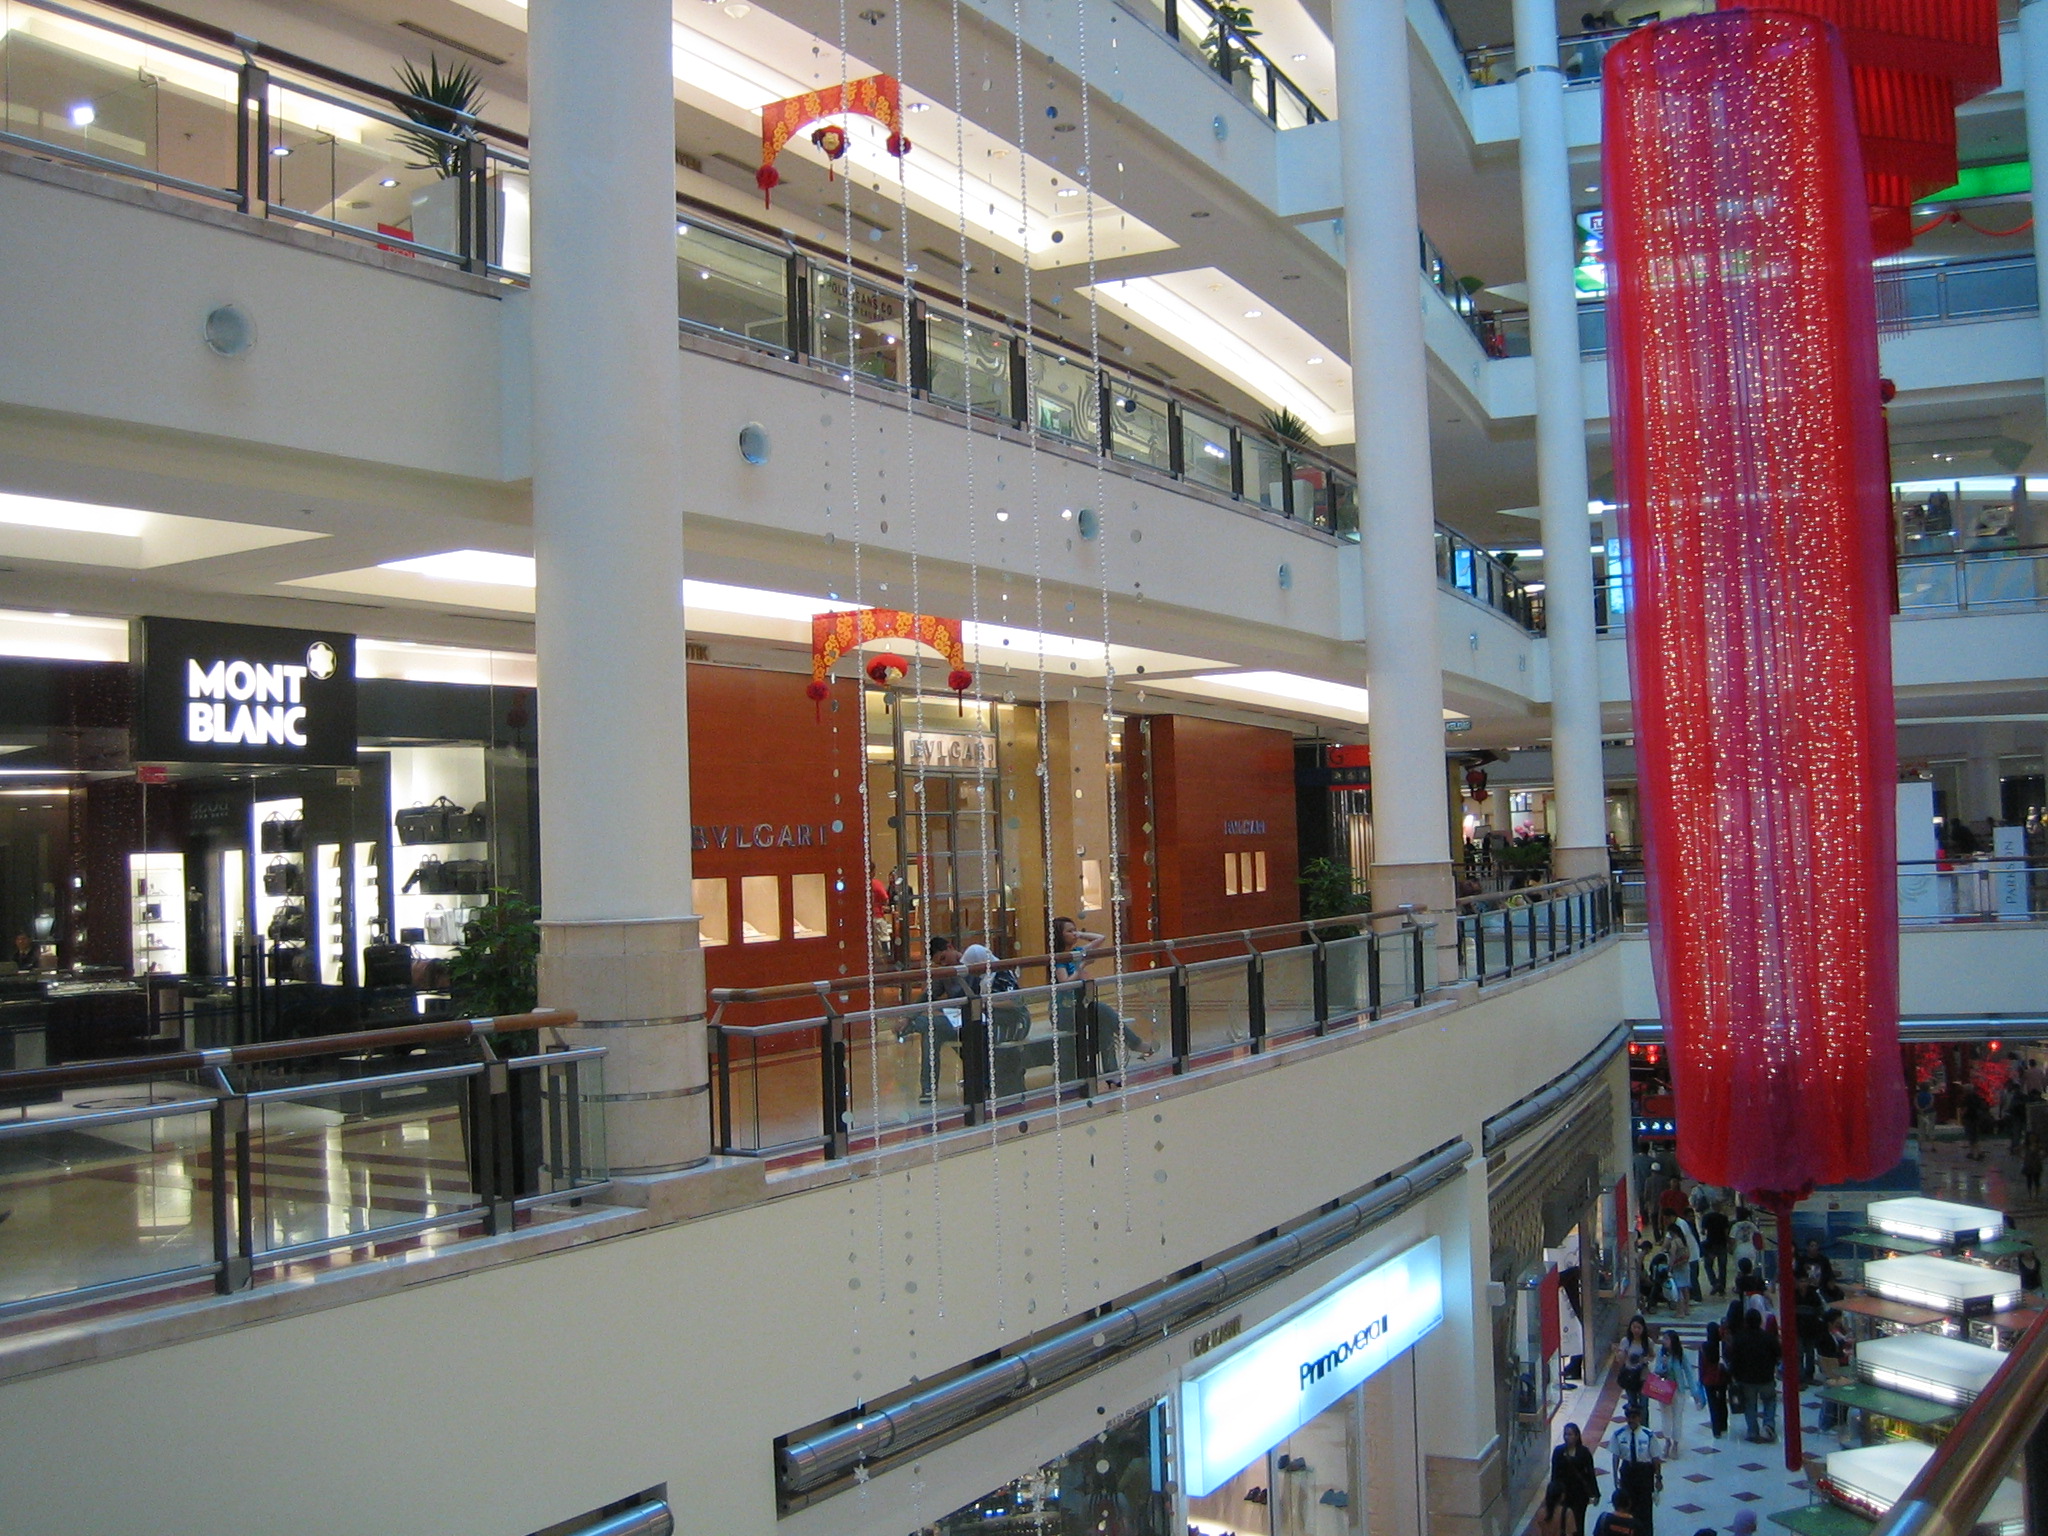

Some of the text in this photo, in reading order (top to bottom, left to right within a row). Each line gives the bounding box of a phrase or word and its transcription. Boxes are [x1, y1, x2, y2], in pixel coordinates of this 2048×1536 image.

[188, 658, 308, 704] MONT
[188, 702, 308, 746] BLANC
[910, 739, 994, 762] BVLGARI
[691, 823, 828, 849] BVLGARI
[2003, 841, 2017, 904] PARKSON
[1300, 1319, 1380, 1391] Primavera
